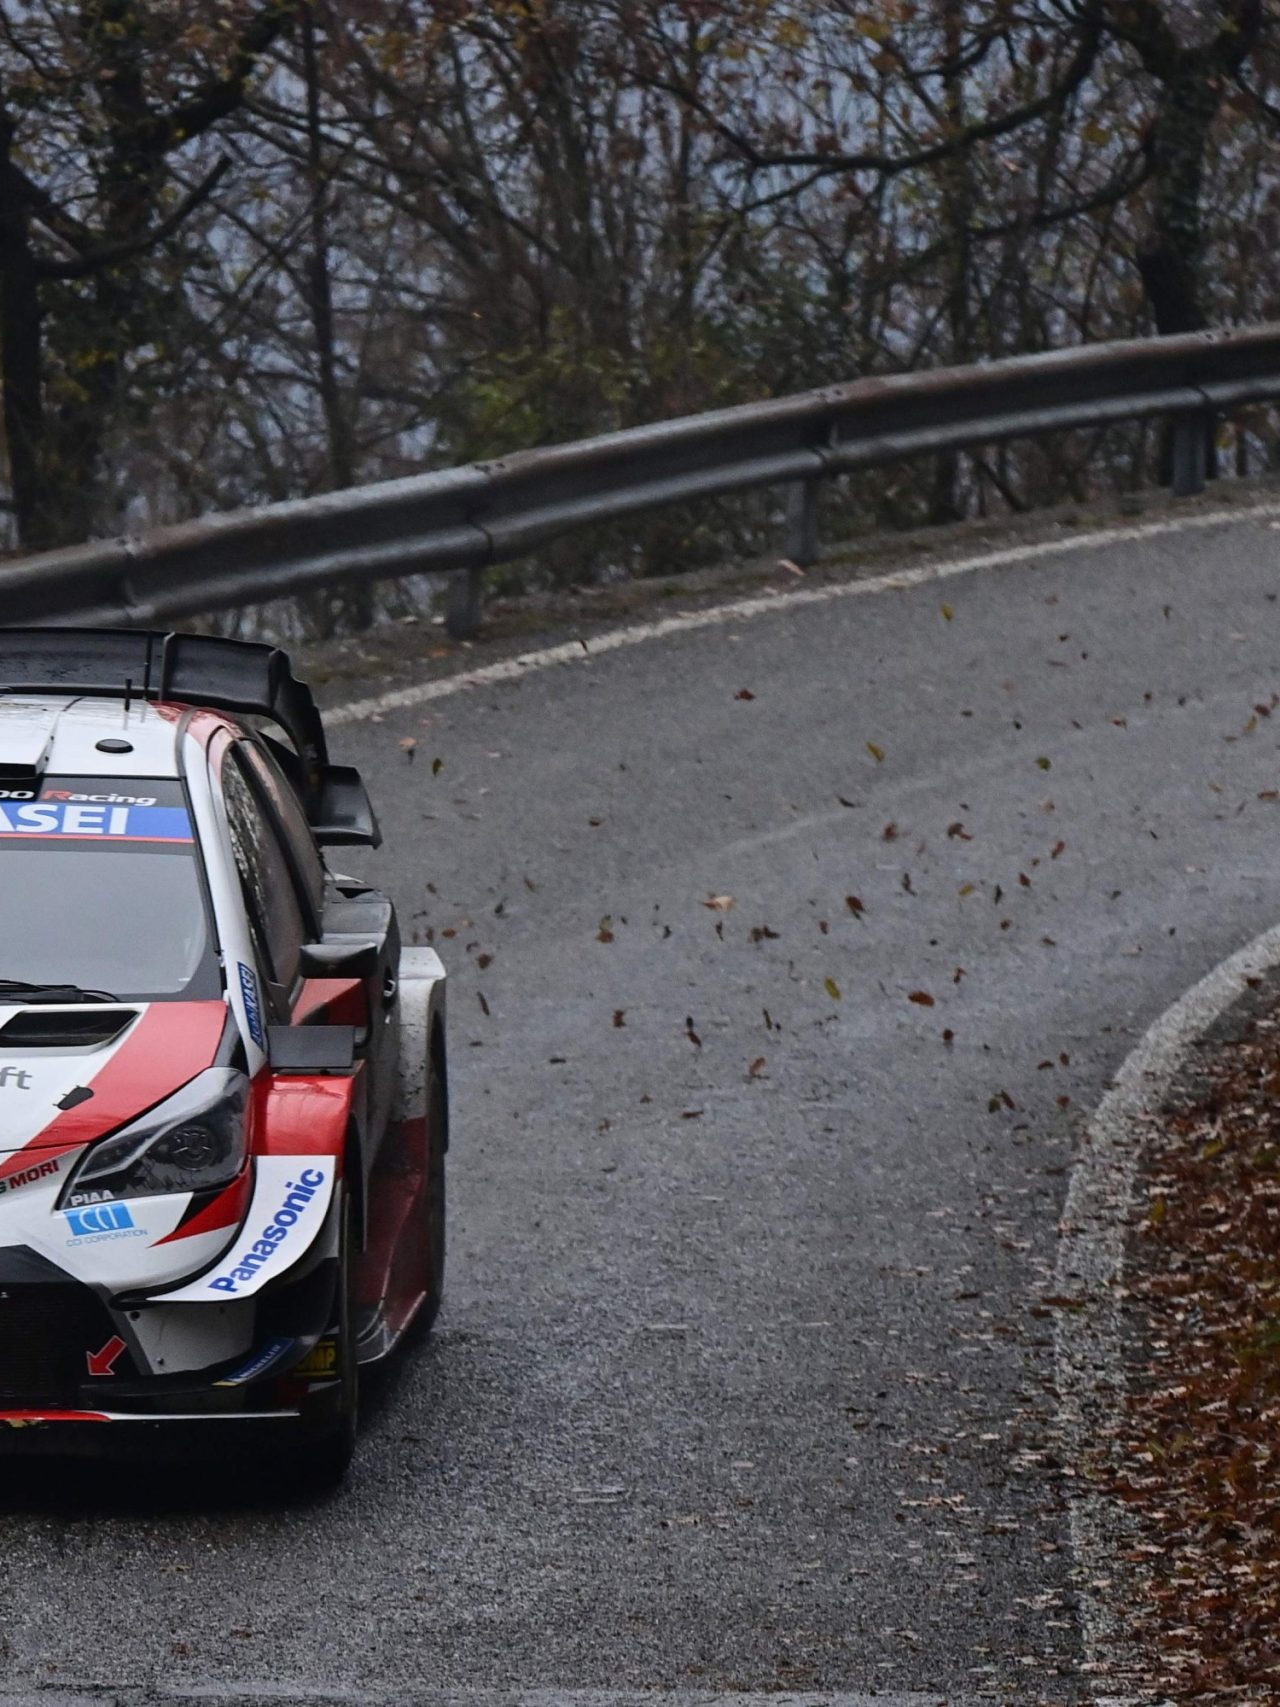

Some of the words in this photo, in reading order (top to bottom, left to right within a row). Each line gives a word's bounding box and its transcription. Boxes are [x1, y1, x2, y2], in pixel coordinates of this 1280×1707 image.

[43, 790, 157, 806] Racing
[8, 1159, 60, 1190] MORI
[70, 1190, 115, 1206] PIAA
[207, 1168, 325, 1293] Panasonic
